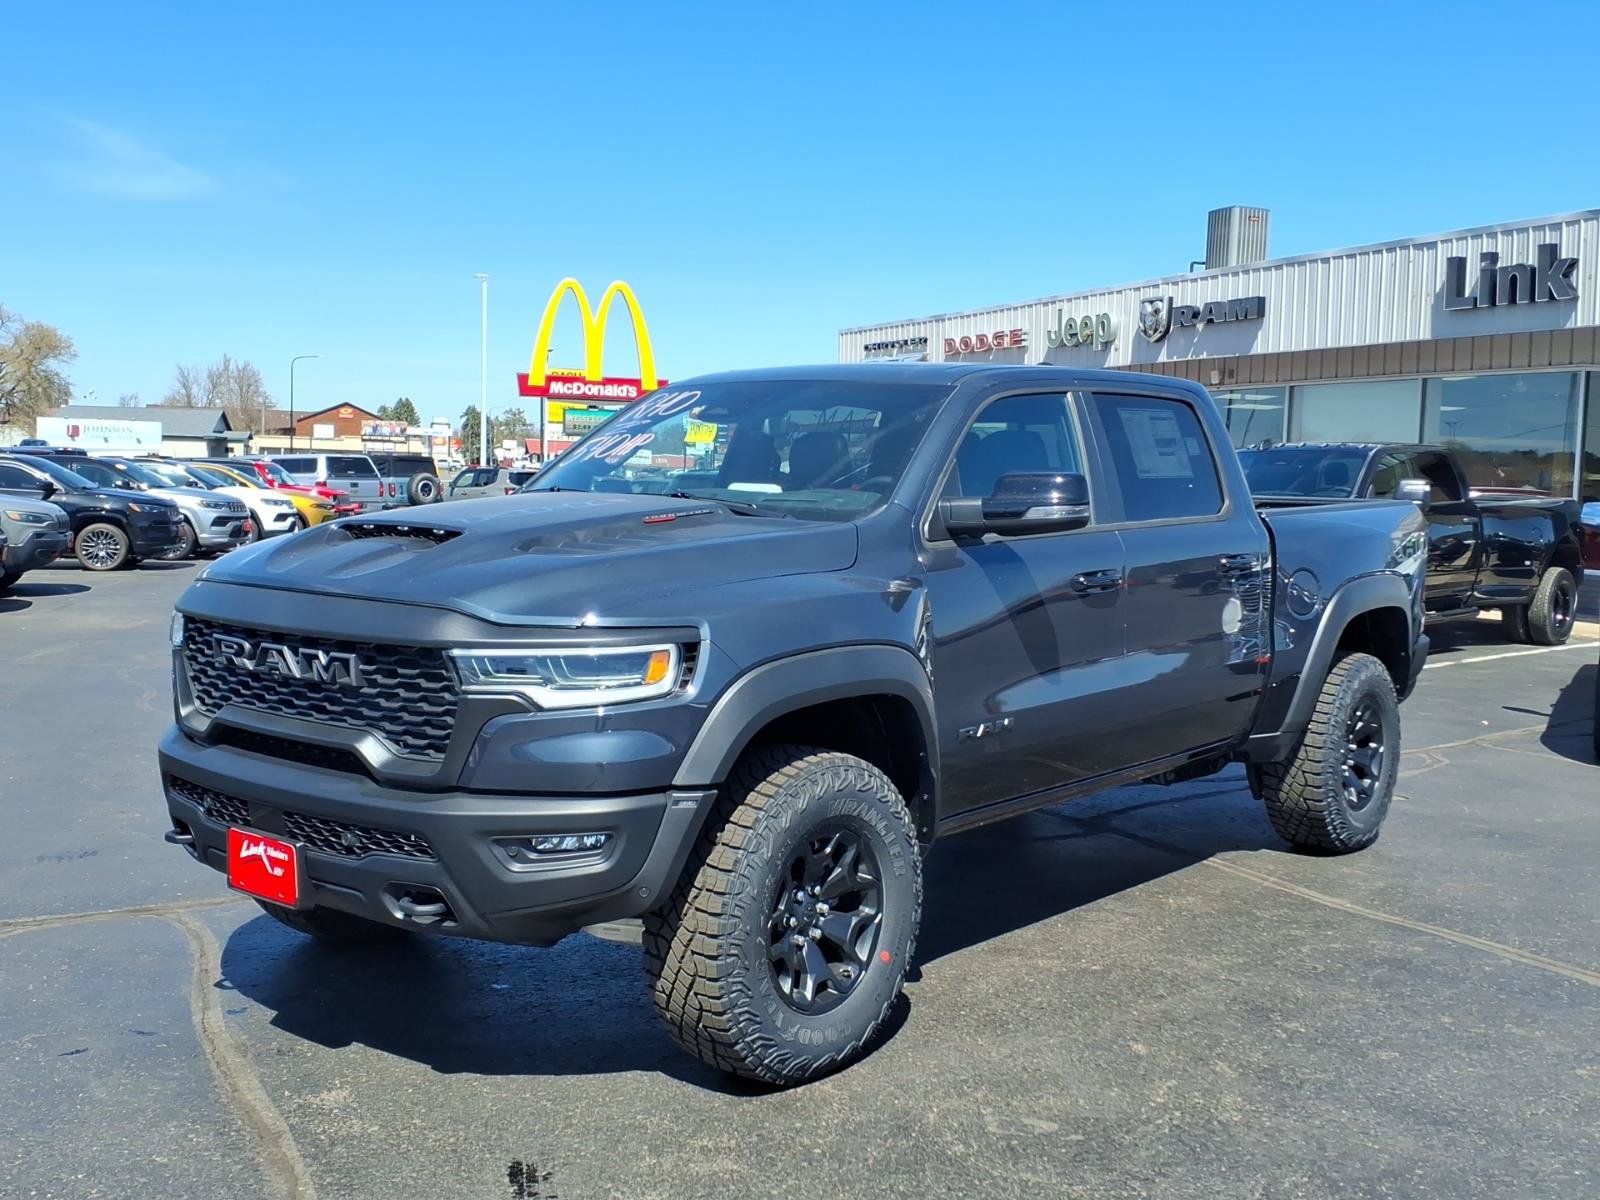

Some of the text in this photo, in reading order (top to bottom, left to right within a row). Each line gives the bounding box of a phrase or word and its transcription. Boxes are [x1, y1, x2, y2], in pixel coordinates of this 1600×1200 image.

[1443, 243, 1579, 311] Link
[1046, 308, 1117, 351] Jeep
[1171, 296, 1265, 328] RAM
[943, 328, 1027, 355] DODGE
[549, 380, 638, 398] McDonald's
[212, 633, 368, 687] RAM
[240, 839, 273, 875] Link
